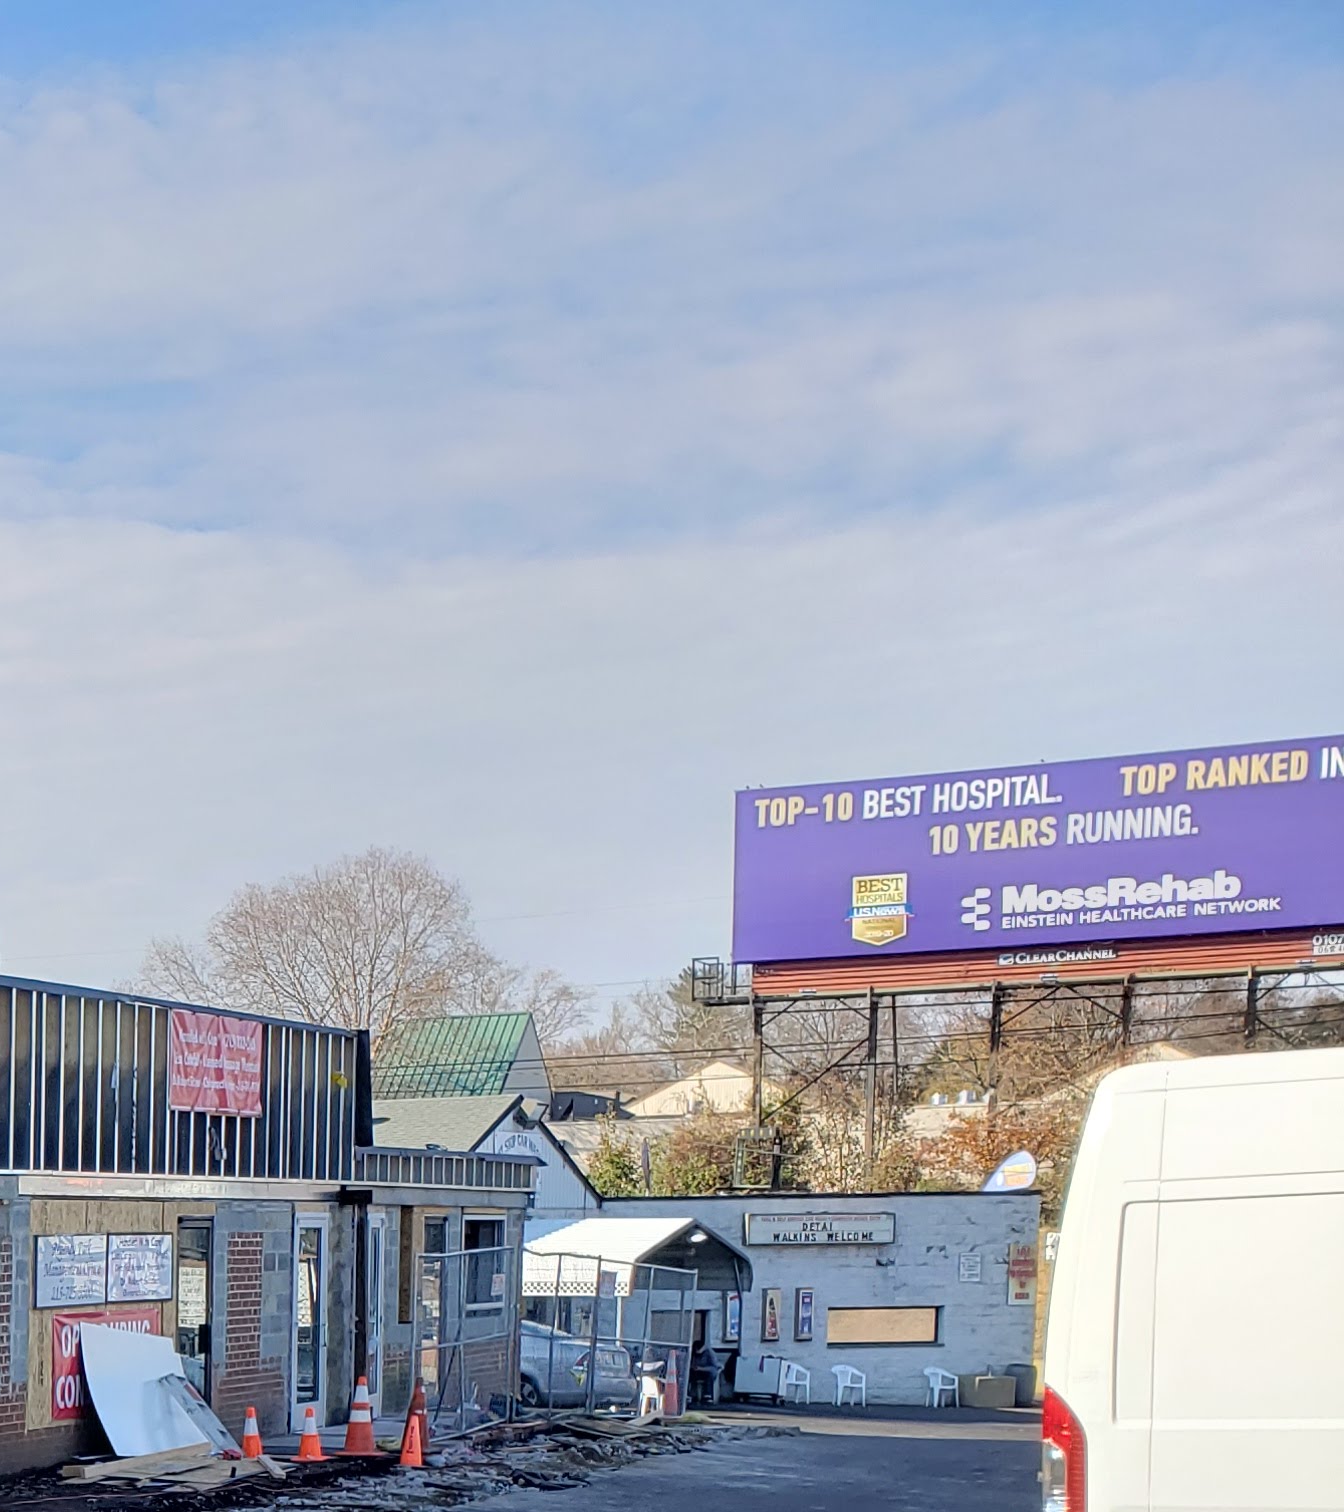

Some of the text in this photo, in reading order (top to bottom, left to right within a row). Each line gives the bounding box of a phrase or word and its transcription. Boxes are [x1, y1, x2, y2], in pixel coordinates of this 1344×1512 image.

[1119, 762, 1178, 797] TOP
[1185, 749, 1310, 791] RANKED
[755, 773, 1064, 829] TOP-10 BEST HOSPITAL.
[929, 803, 1200, 856] 10 YEARS RUNNING.
[856, 877, 904, 894] BEST
[856, 892, 904, 905] HOSPITALS
[1001, 870, 1242, 914] MossRehab
[1001, 897, 1282, 930] EINSTEIN HEALTHCARE NETWORK
[772, 1231, 874, 1243] WALKINS WELCOME
